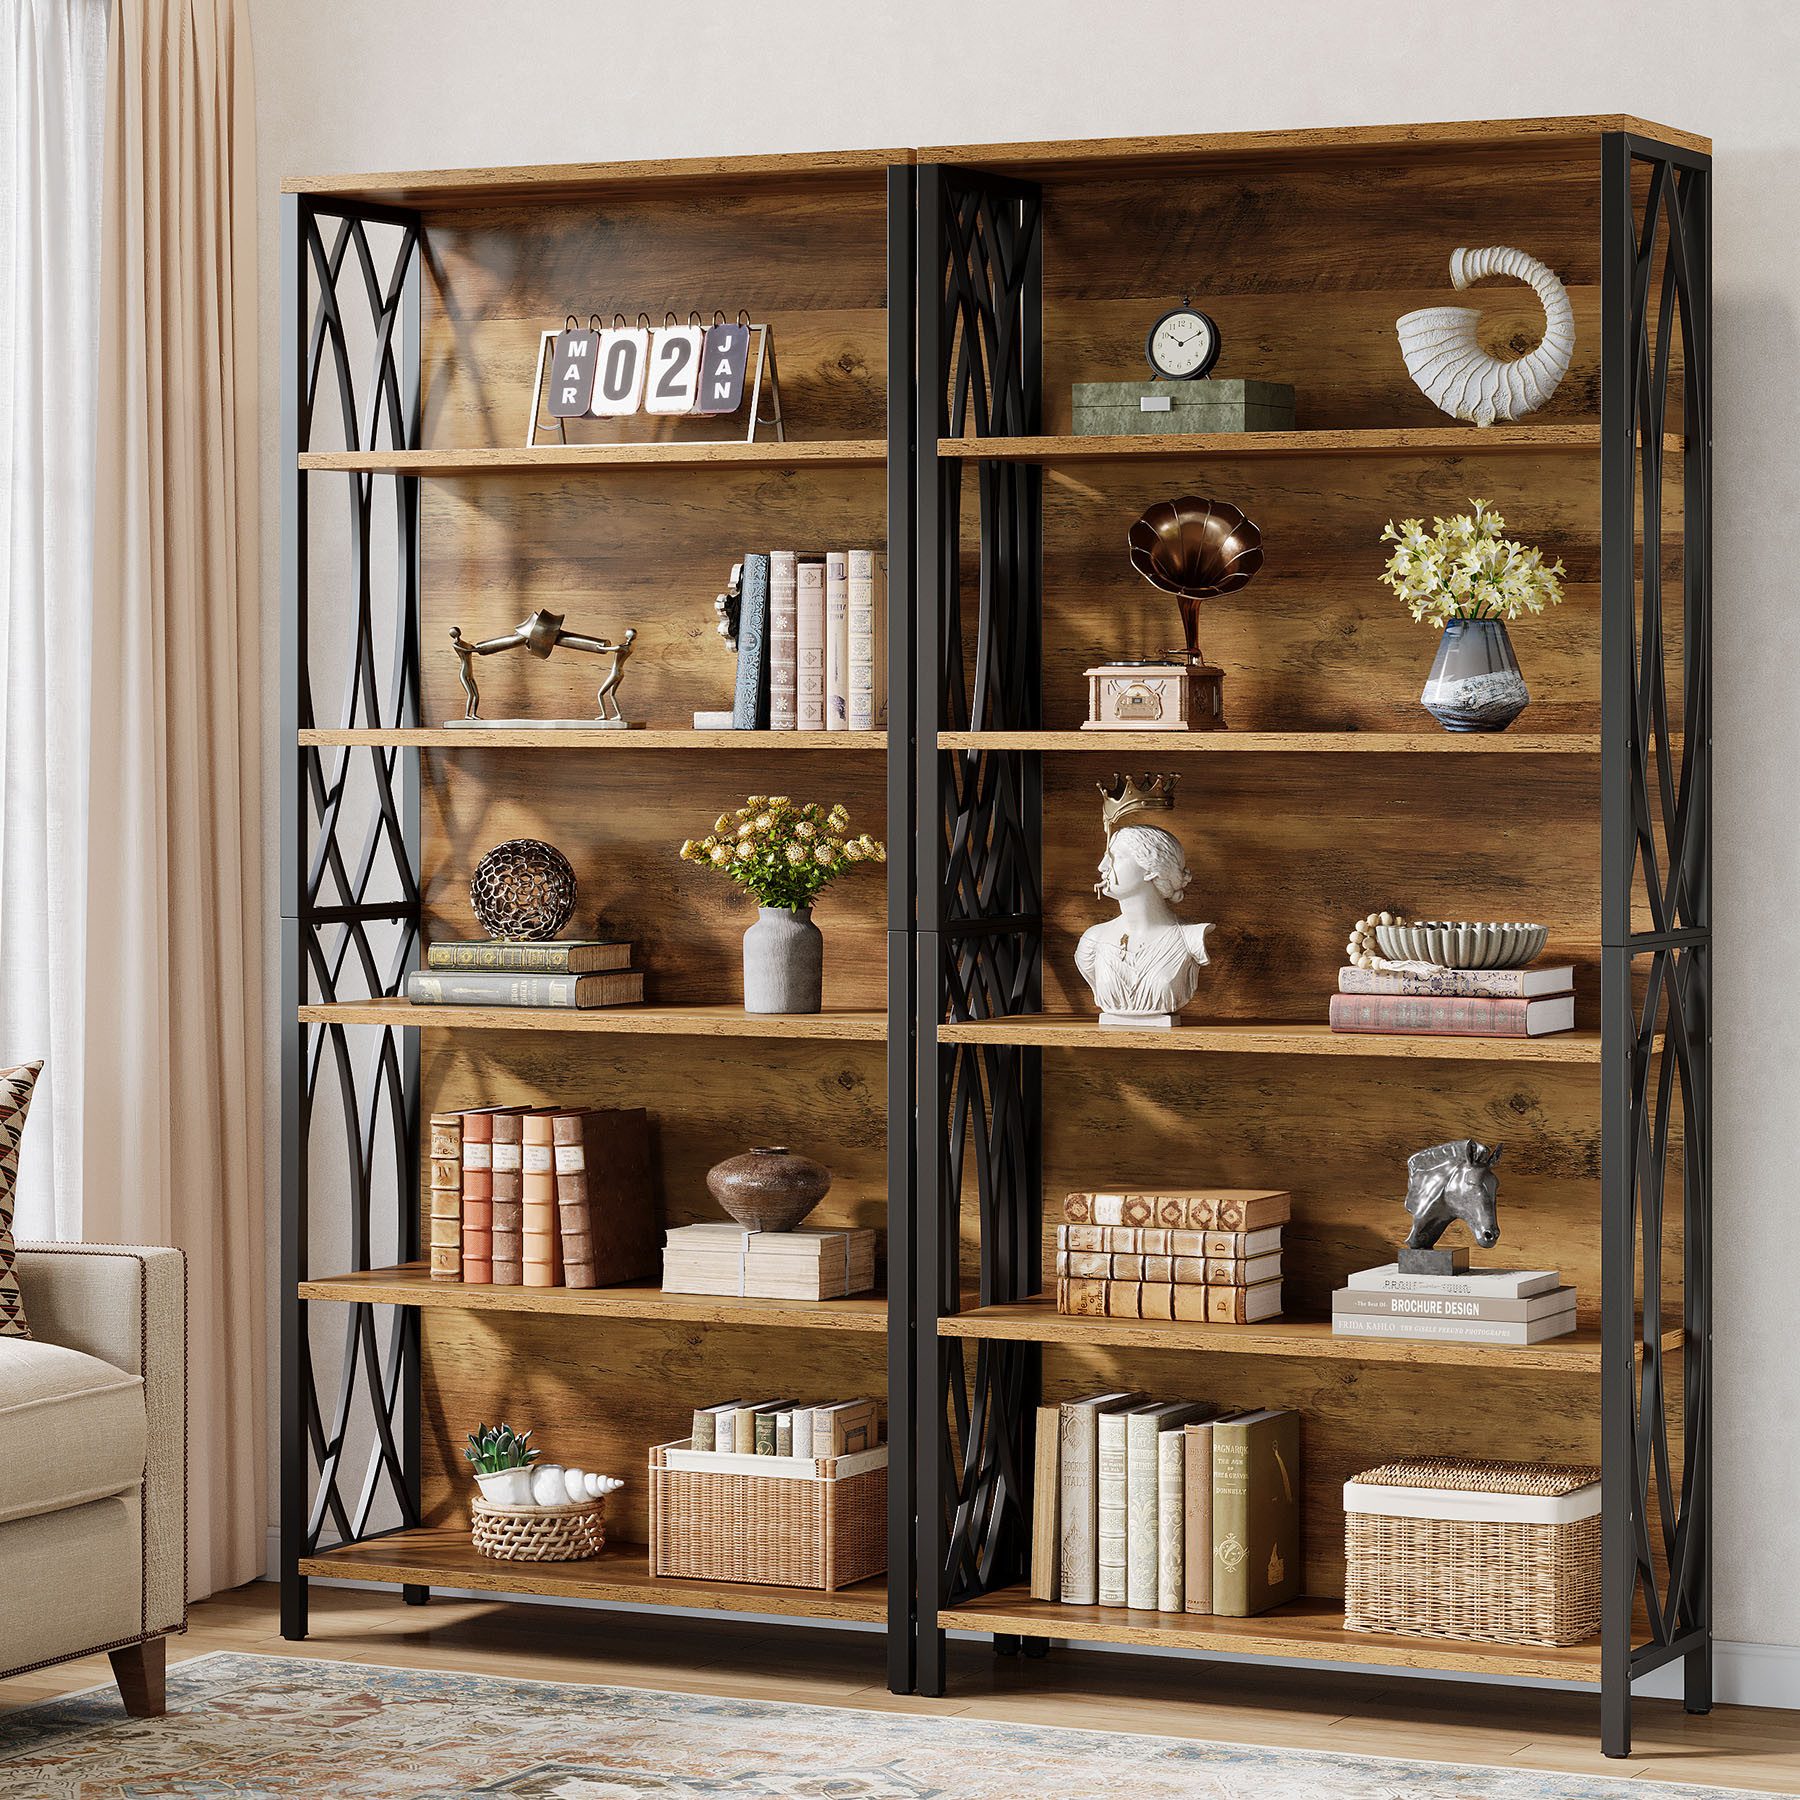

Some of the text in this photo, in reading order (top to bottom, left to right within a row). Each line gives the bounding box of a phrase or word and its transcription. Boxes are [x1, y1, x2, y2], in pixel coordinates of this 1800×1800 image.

[561, 340, 588, 404] MAR
[714, 335, 733, 400] JAN
[1338, 1320, 1364, 1330] FRIDA
[1366, 1321, 1396, 1332] KAHLO
[1391, 1298, 1443, 1314] BROCHURE
[1445, 1301, 1480, 1316] DESIGN
